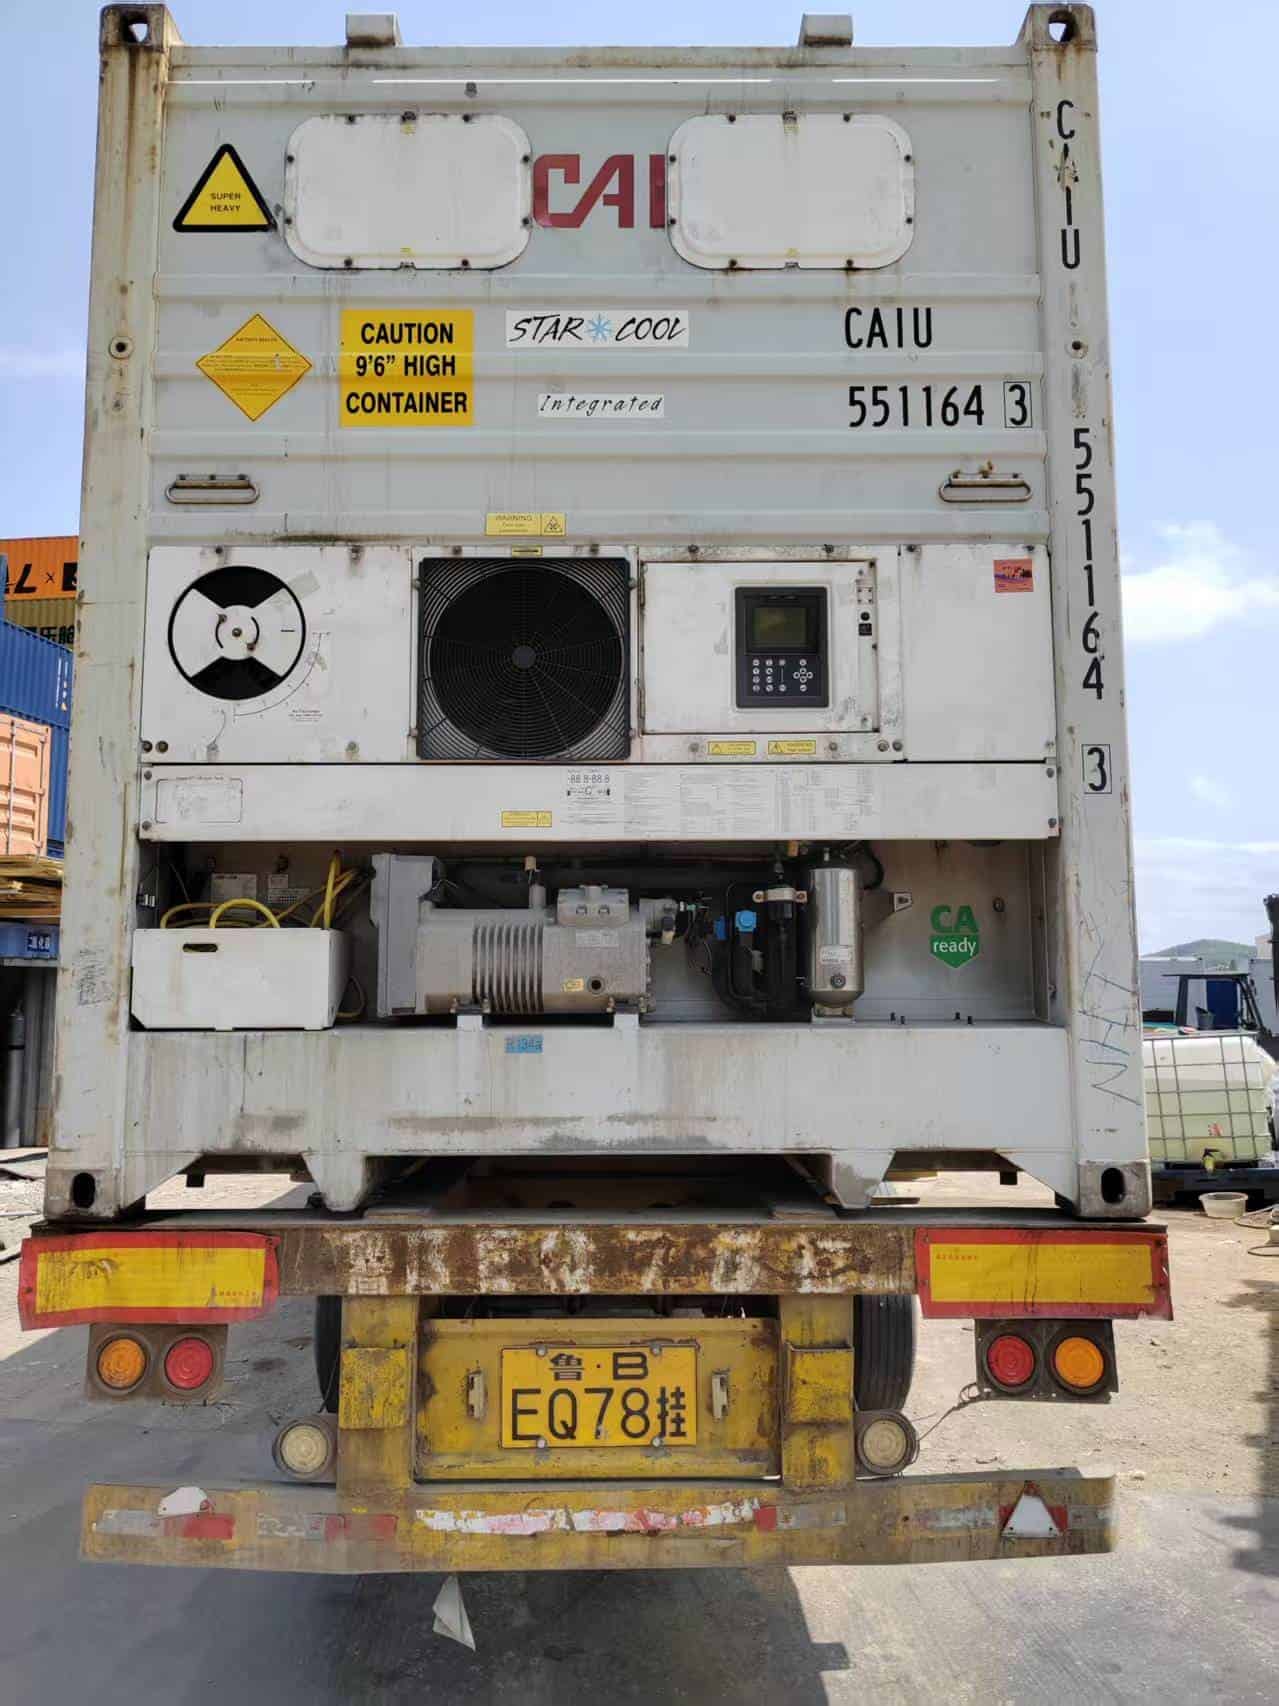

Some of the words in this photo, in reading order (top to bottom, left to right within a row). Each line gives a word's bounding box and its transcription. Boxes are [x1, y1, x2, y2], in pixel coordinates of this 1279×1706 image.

[210, 192, 241, 201] SUPER
[533, 154, 666, 228] CAI
[210, 204, 241, 213] HEAVY
[360, 322, 454, 345] CAUTION
[509, 313, 585, 343] STAR
[615, 317, 687, 341] COOL
[844, 307, 933, 349] CAIU
[403, 354, 456, 376] HIGH
[346, 391, 468, 414] CONTAINER
[539, 394, 664, 417] Integrated
[848, 384, 985, 428] 551164
[1007, 383, 1028, 427] 3
[1073, 428, 1104, 700] 551164
[1086, 746, 1109, 792] 3
[931, 905, 979, 933] CA
[933, 937, 977, 957] ready
[511, 1385, 687, 1441] EQ78挂
